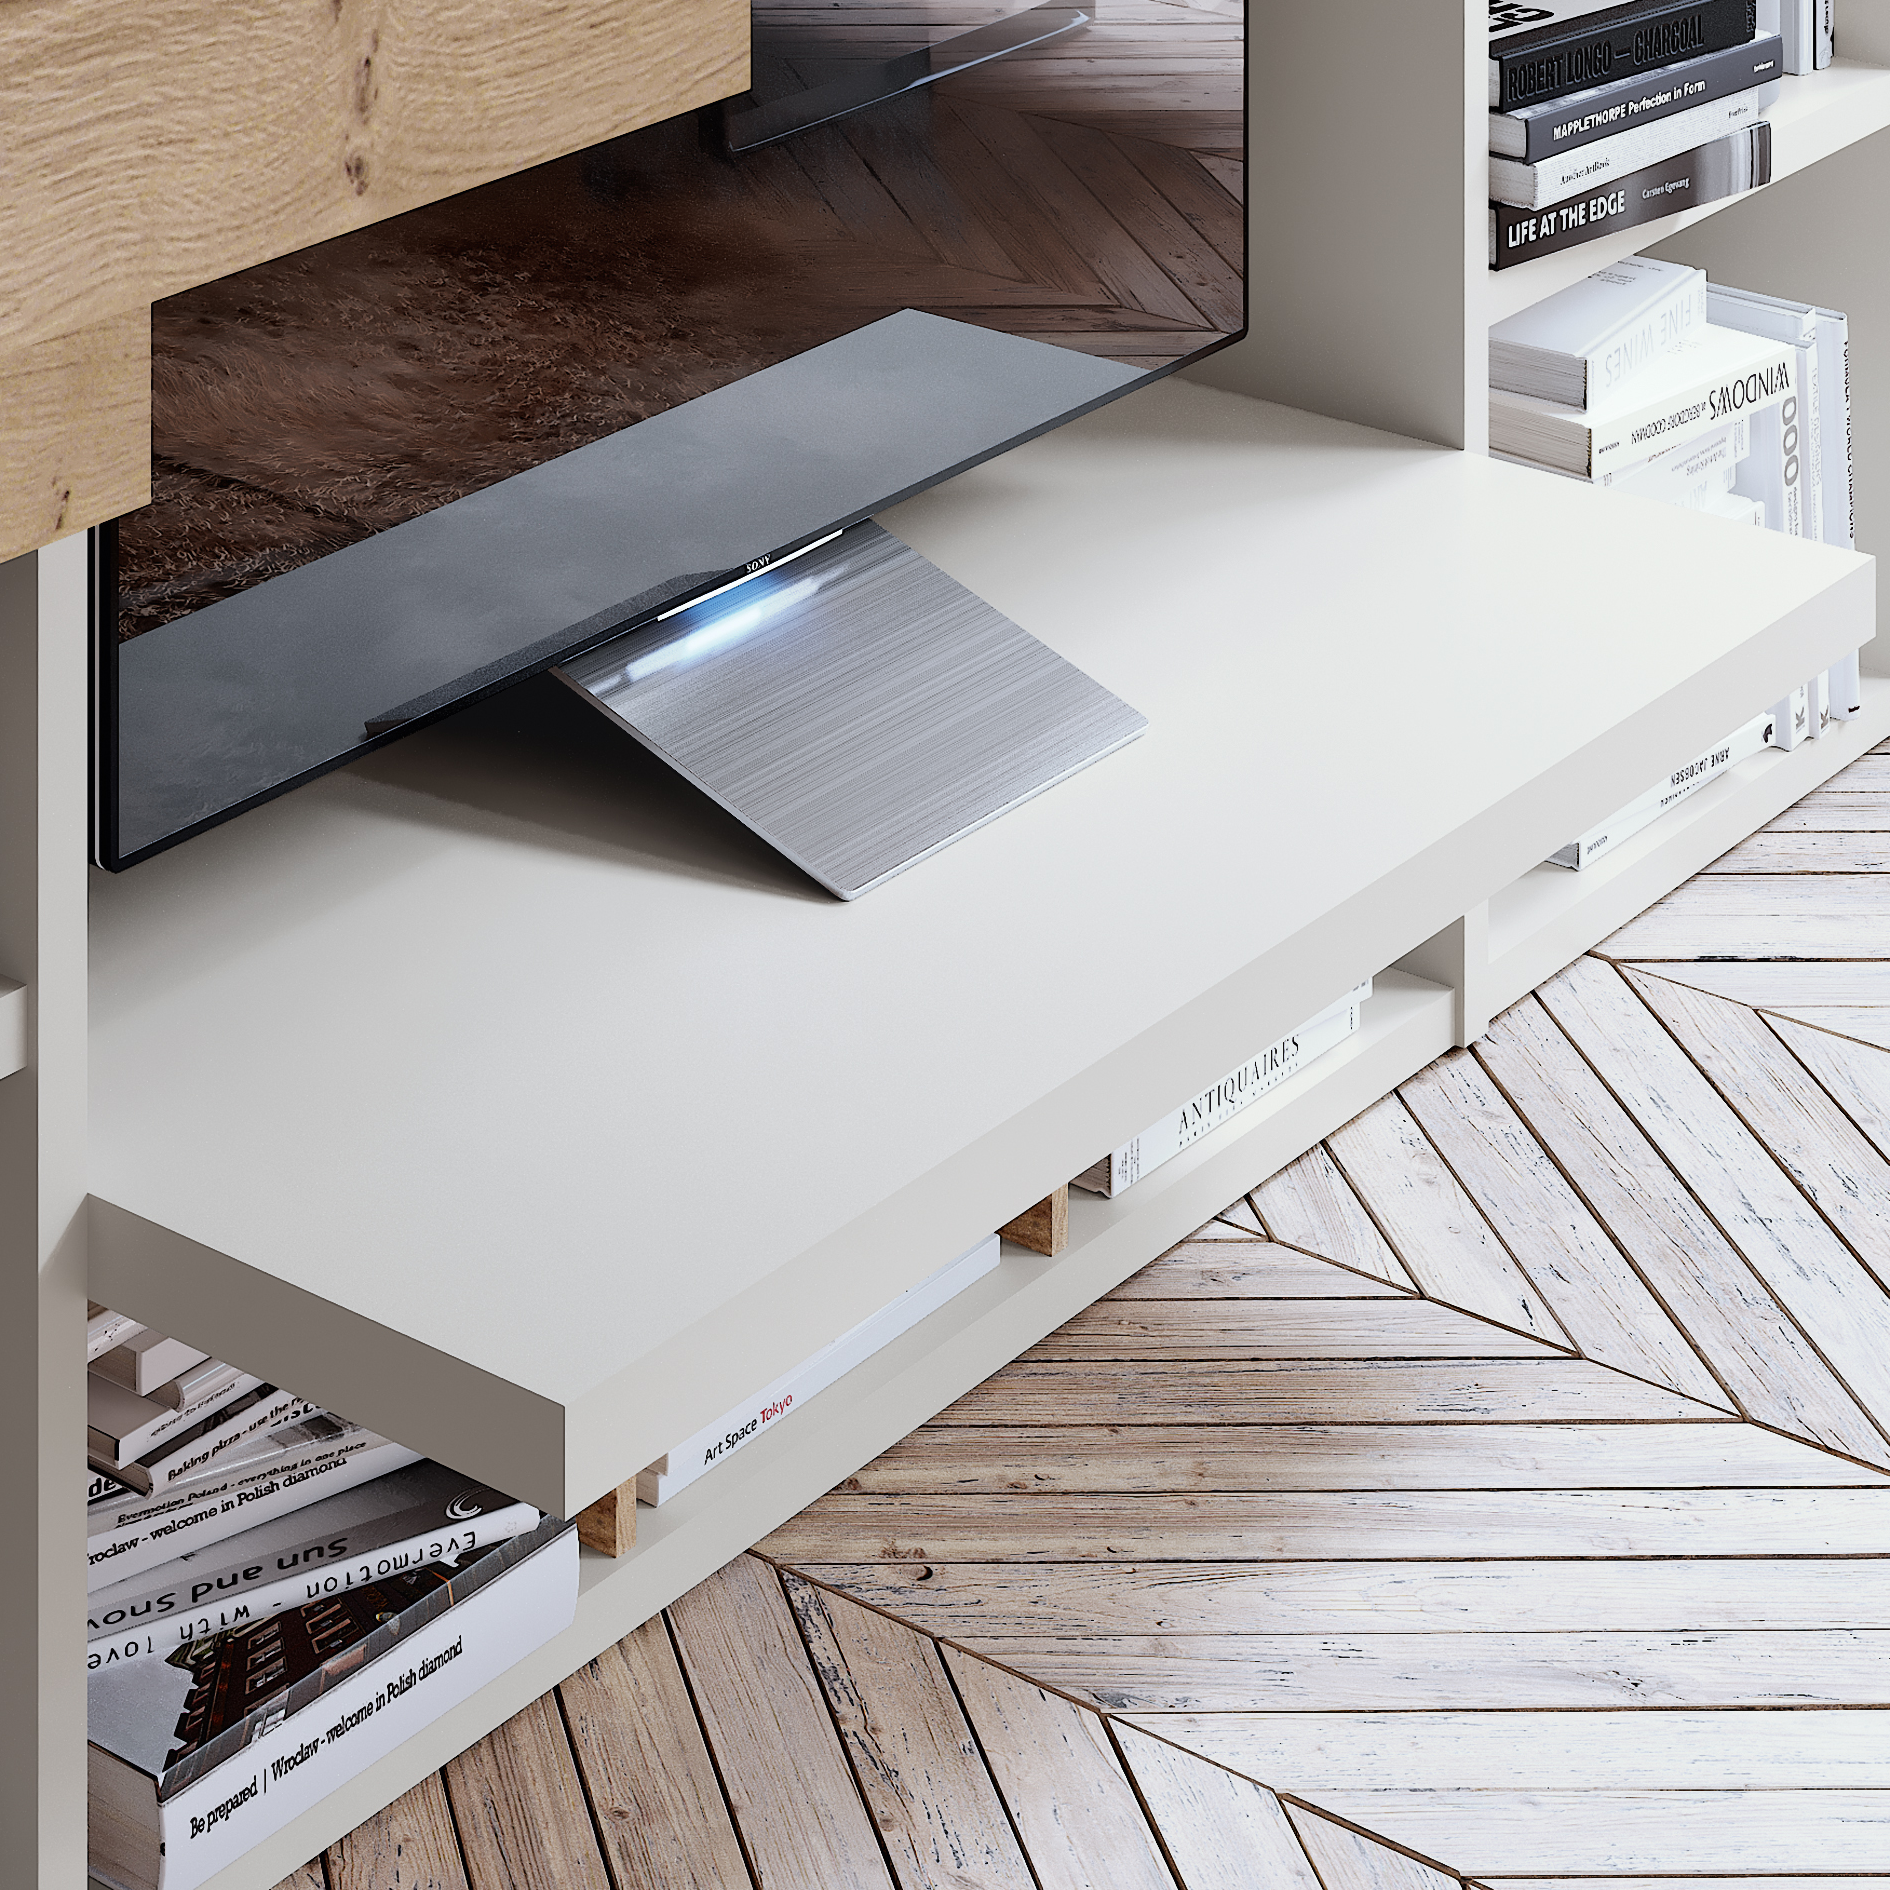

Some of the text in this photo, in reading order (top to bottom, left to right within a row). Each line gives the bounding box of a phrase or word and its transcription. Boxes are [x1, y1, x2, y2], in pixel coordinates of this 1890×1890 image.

[1506, 56, 1561, 102] ROBERT
[1564, 41, 1611, 85] LONGO
[1633, 14, 1704, 66] CHARCOAL
[1553, 80, 1706, 141] MAPPLETHORPE Perfection in Form
[1508, 190, 1625, 248] LIFE AT THE EDGE
[746, 554, 771, 574] SONY
[1670, 747, 1730, 788] ARNE JACOBSEN
[1178, 1034, 1300, 1135] ANTIQUAIRES
[168, 1450, 209, 1482] Baking
[211, 1432, 241, 1455] pizza
[248, 1415, 268, 1436] use
[268, 1403, 288, 1419] the
[704, 1394, 792, 1465] Art Space Tokyo
[117, 1499, 184, 1524] Evermotion
[188, 1482, 228, 1502] Poland
[238, 1462, 298, 1487] everything
[300, 1459, 312, 1469] in
[314, 1452, 336, 1463] one
[337, 1442, 367, 1458] place
[150, 1506, 218, 1541] welcome
[220, 1495, 236, 1513] in
[236, 1481, 280, 1506] Polish
[282, 1457, 348, 1488] diamond
[190, 1564, 264, 1604] and
[277, 1536, 348, 1571] Sun
[87, 1530, 477, 1669] Evermotion with love
[190, 1635, 462, 1838] Be prepared Wroclaw welcome in Polish diamond
